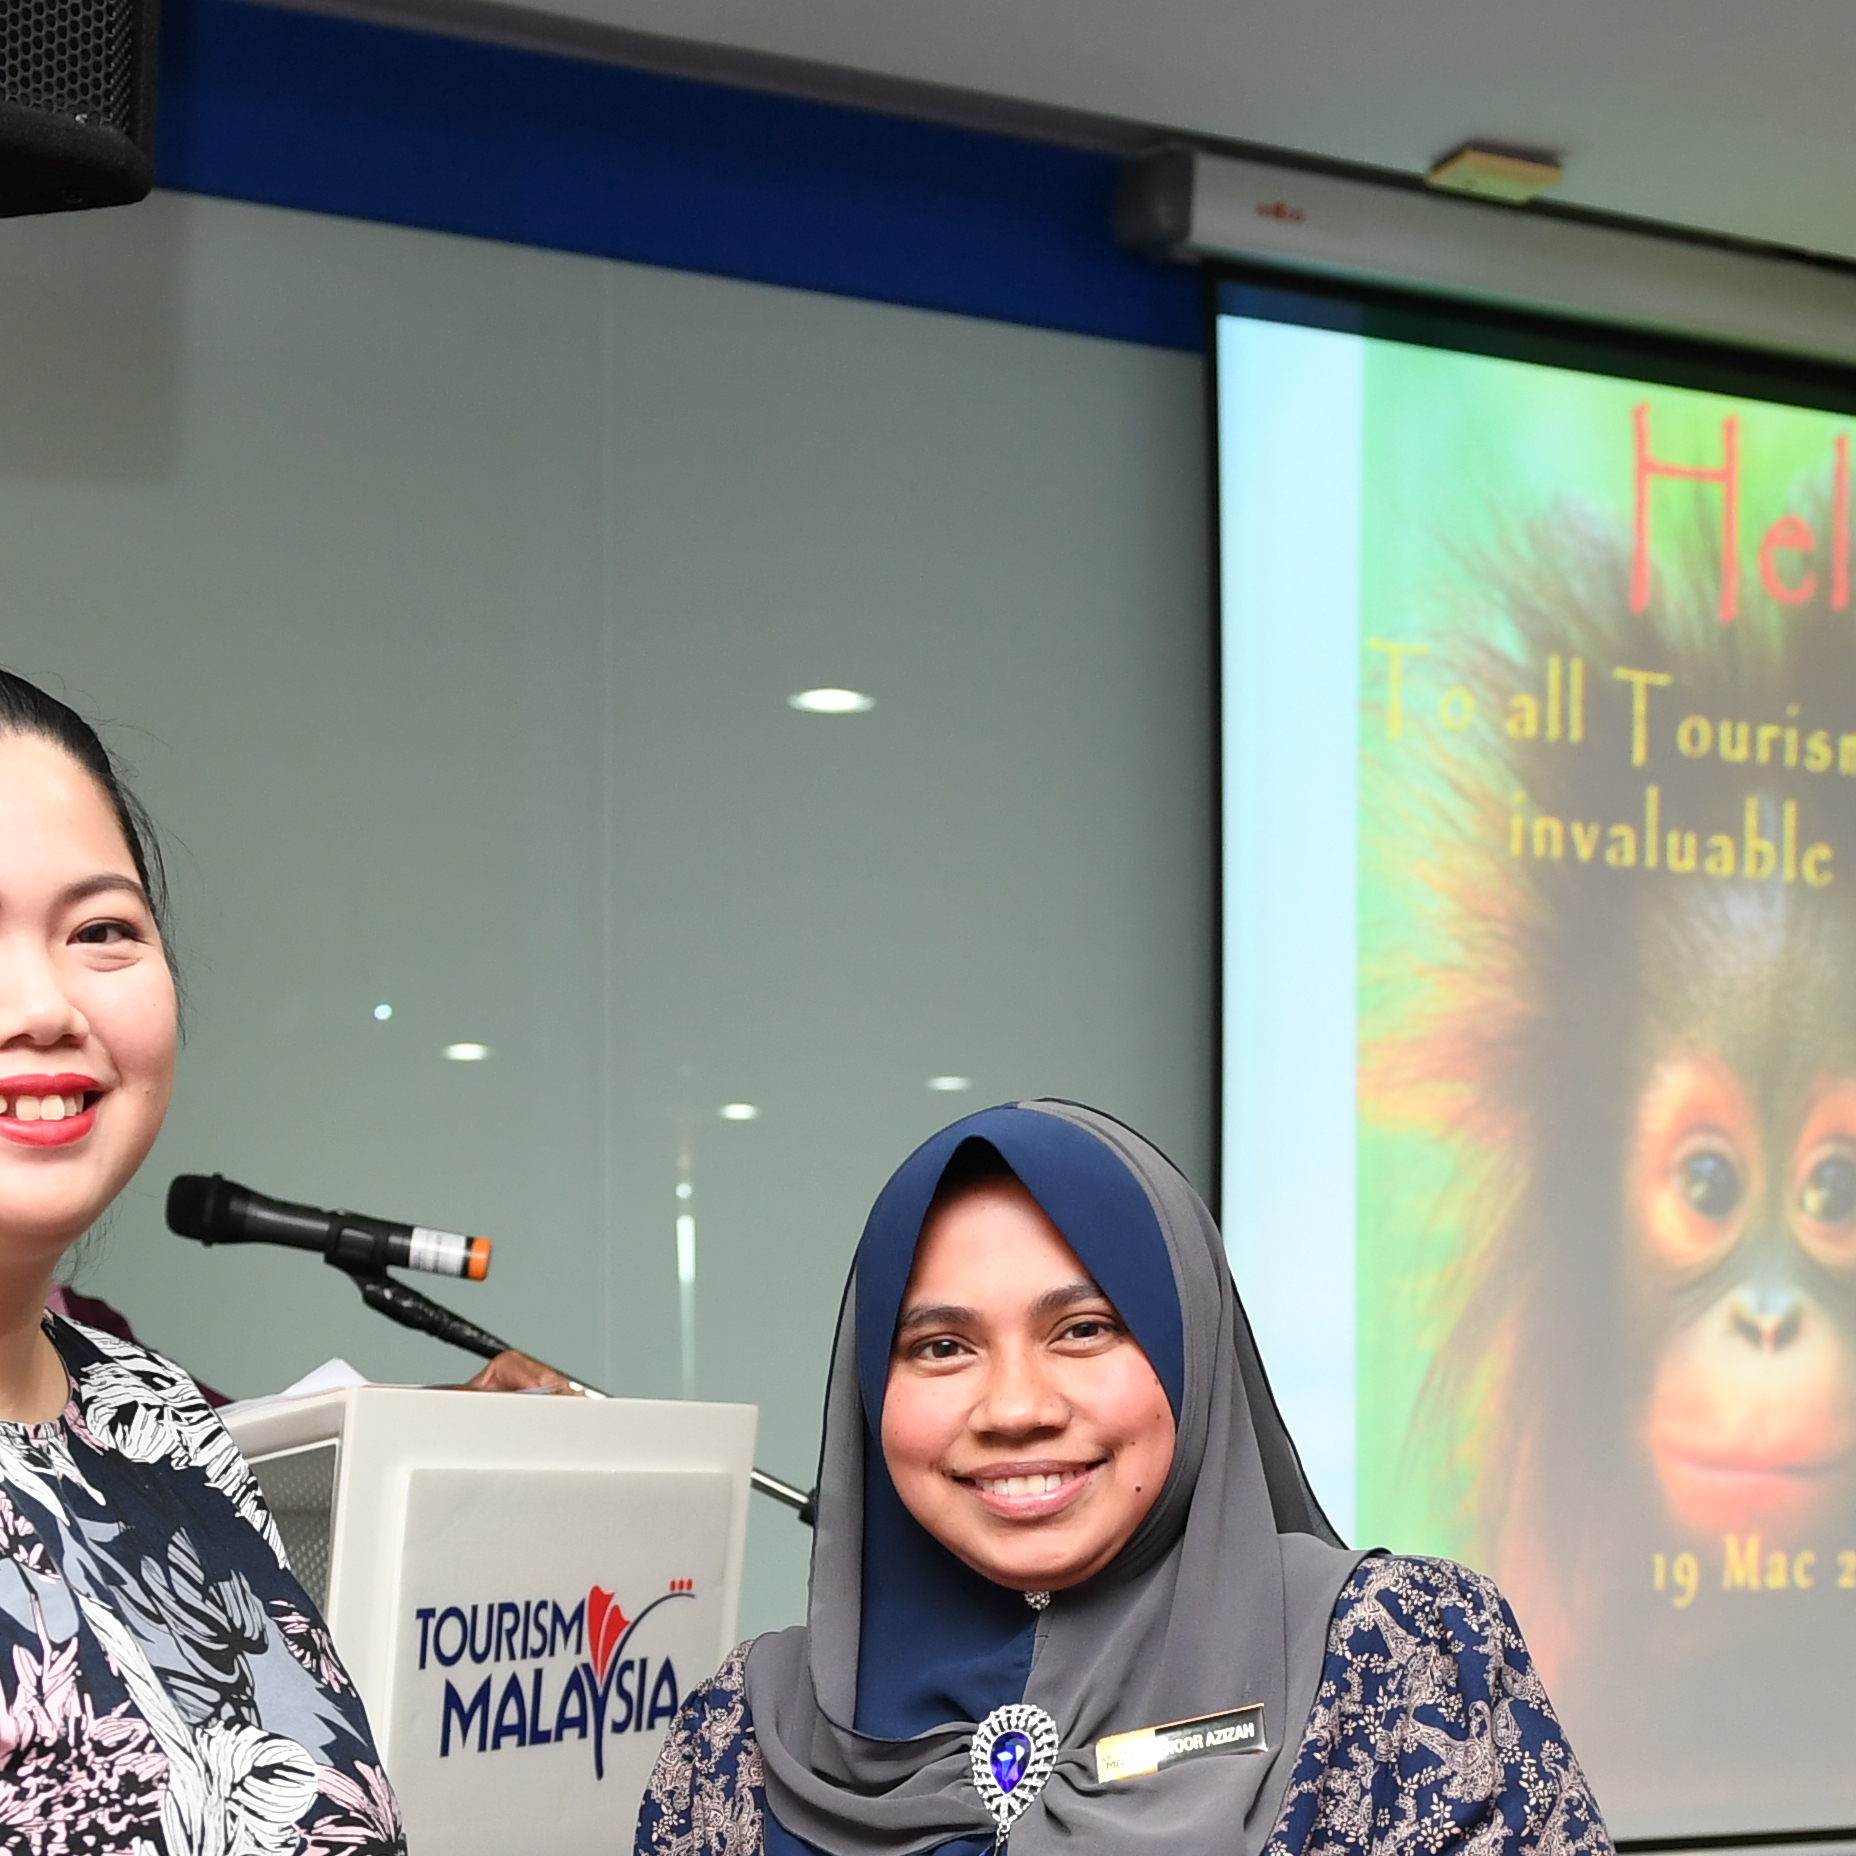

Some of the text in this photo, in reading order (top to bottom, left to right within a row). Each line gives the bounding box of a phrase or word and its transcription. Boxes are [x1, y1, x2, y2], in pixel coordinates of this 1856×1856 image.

[1367, 637, 1475, 742] To
[1506, 654, 1584, 742] all
[1508, 785, 1834, 888] invaluable
[1653, 1551, 1699, 1608] 19
[1722, 1532, 1816, 1591] Mac
[416, 1598, 585, 1670] TOURISM
[440, 1655, 680, 1781] MALAYSIA
[1205, 1722, 1255, 1748] AZIZAH
